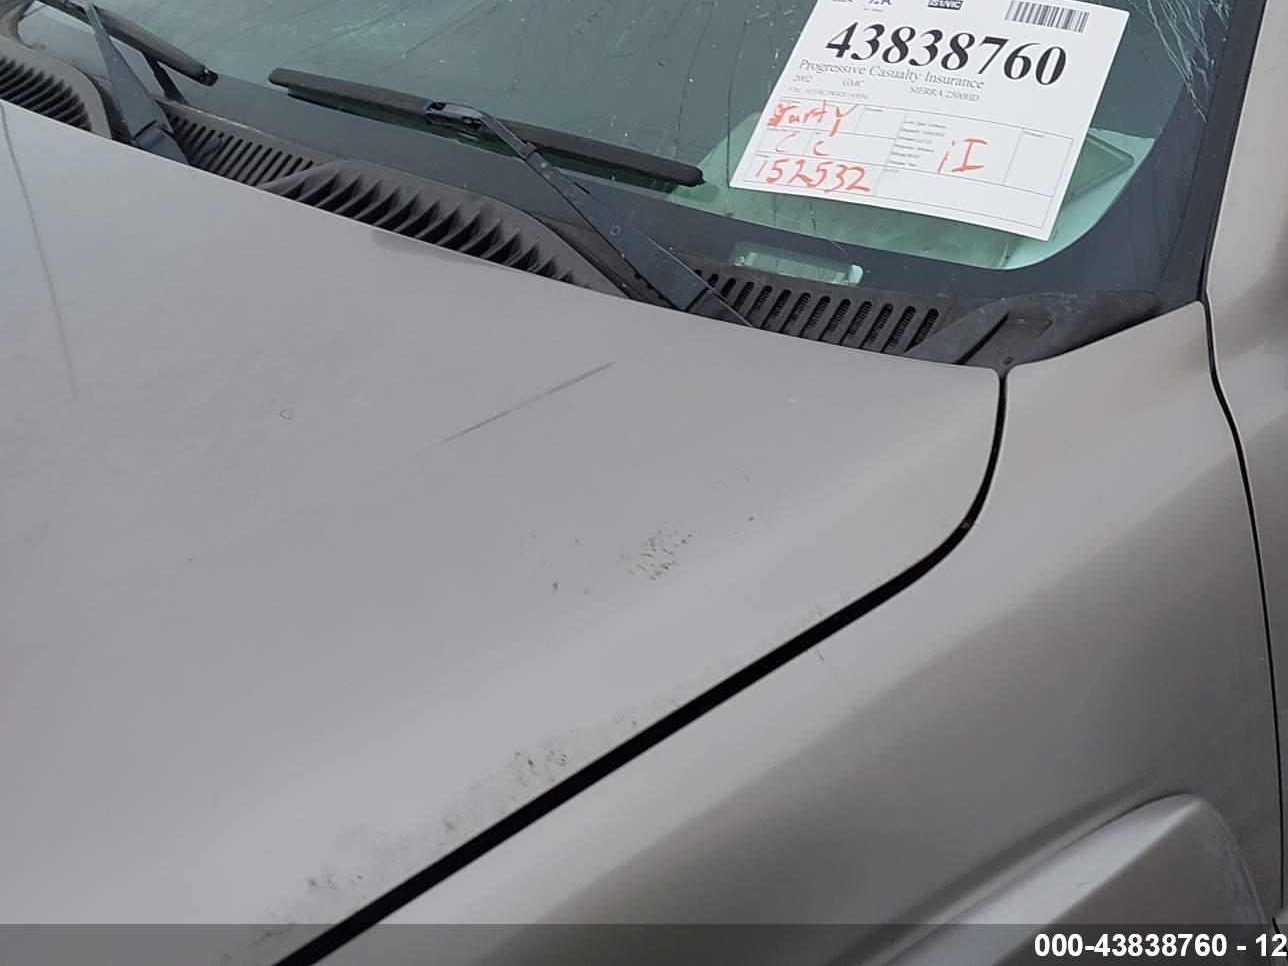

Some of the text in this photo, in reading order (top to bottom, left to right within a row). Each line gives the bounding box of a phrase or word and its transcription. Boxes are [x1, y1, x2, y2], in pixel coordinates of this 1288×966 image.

[825, 21, 1067, 86] 43838760
[798, 59, 985, 90] Progressive Casualty Insurance
[908, 84, 943, 98] SIERRA
[944, 89, 981, 102] 2500HD
